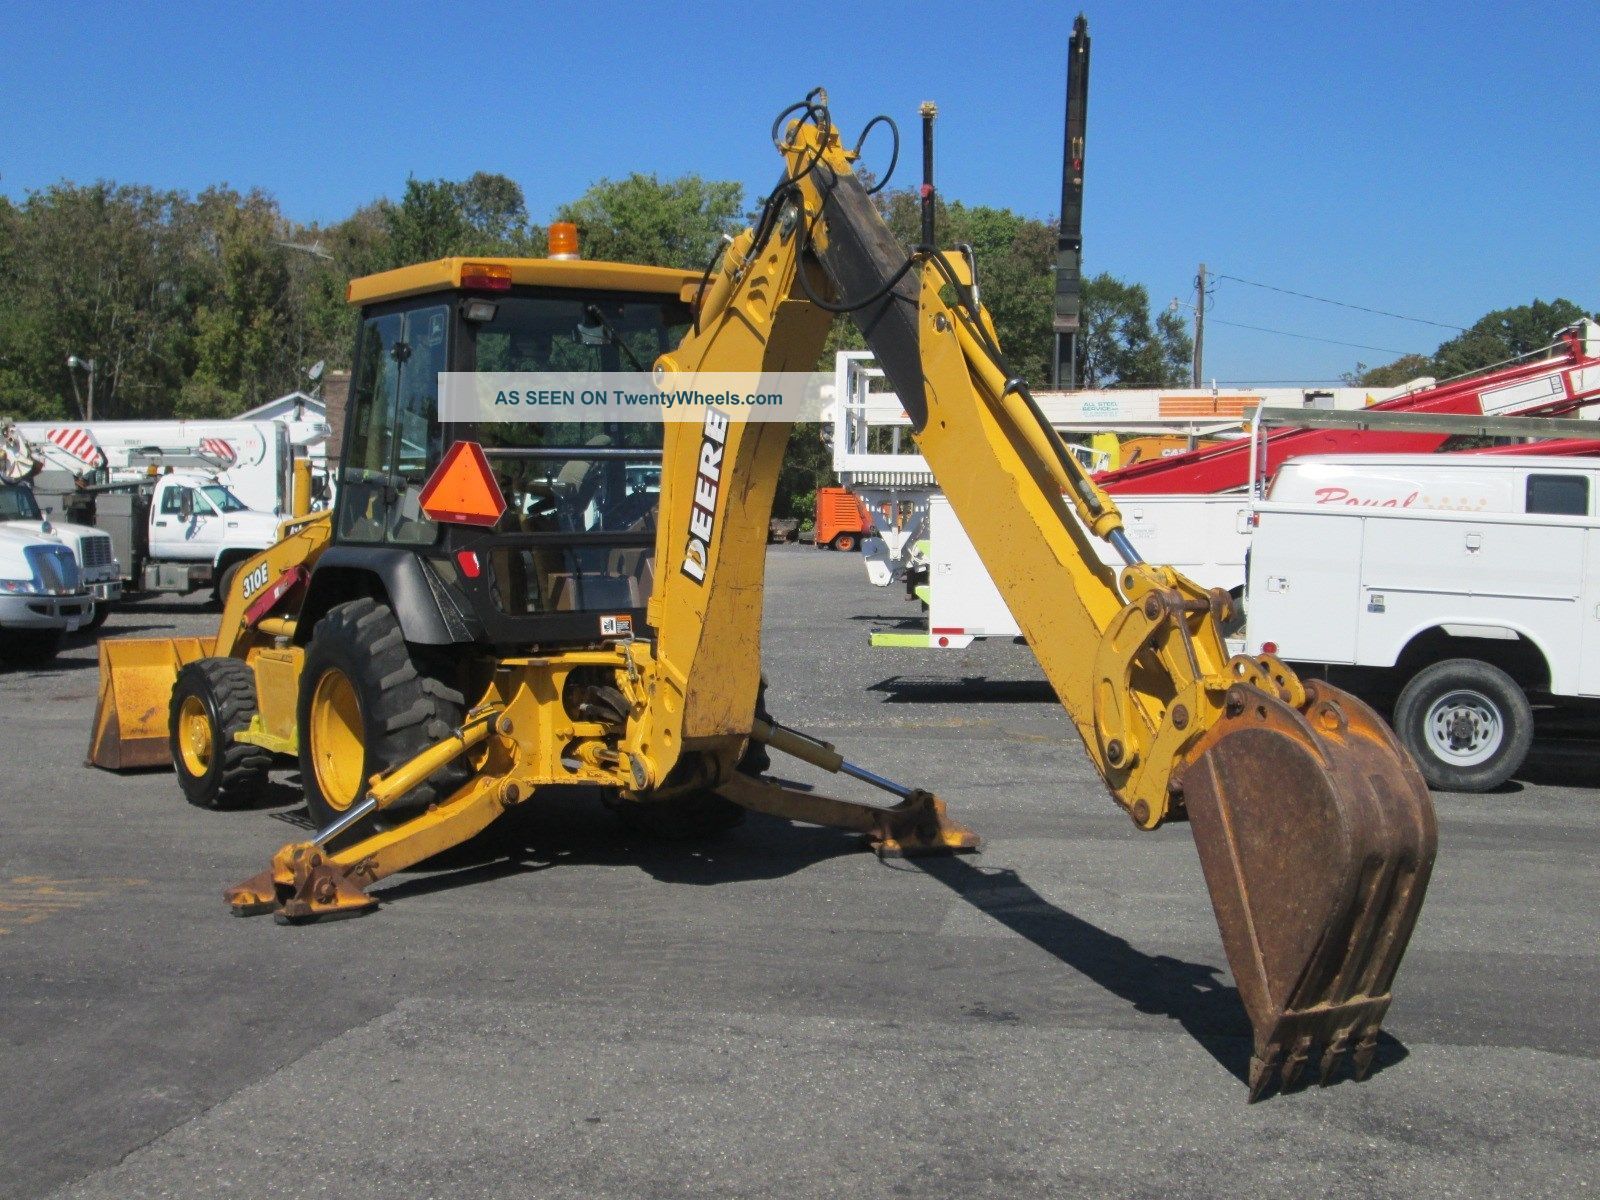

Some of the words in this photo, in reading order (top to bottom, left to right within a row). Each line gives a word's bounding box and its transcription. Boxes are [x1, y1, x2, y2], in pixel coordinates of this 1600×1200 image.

[1162, 448, 1188, 457] CAS
[681, 406, 729, 586] DEERE
[243, 561, 268, 599] 310E
